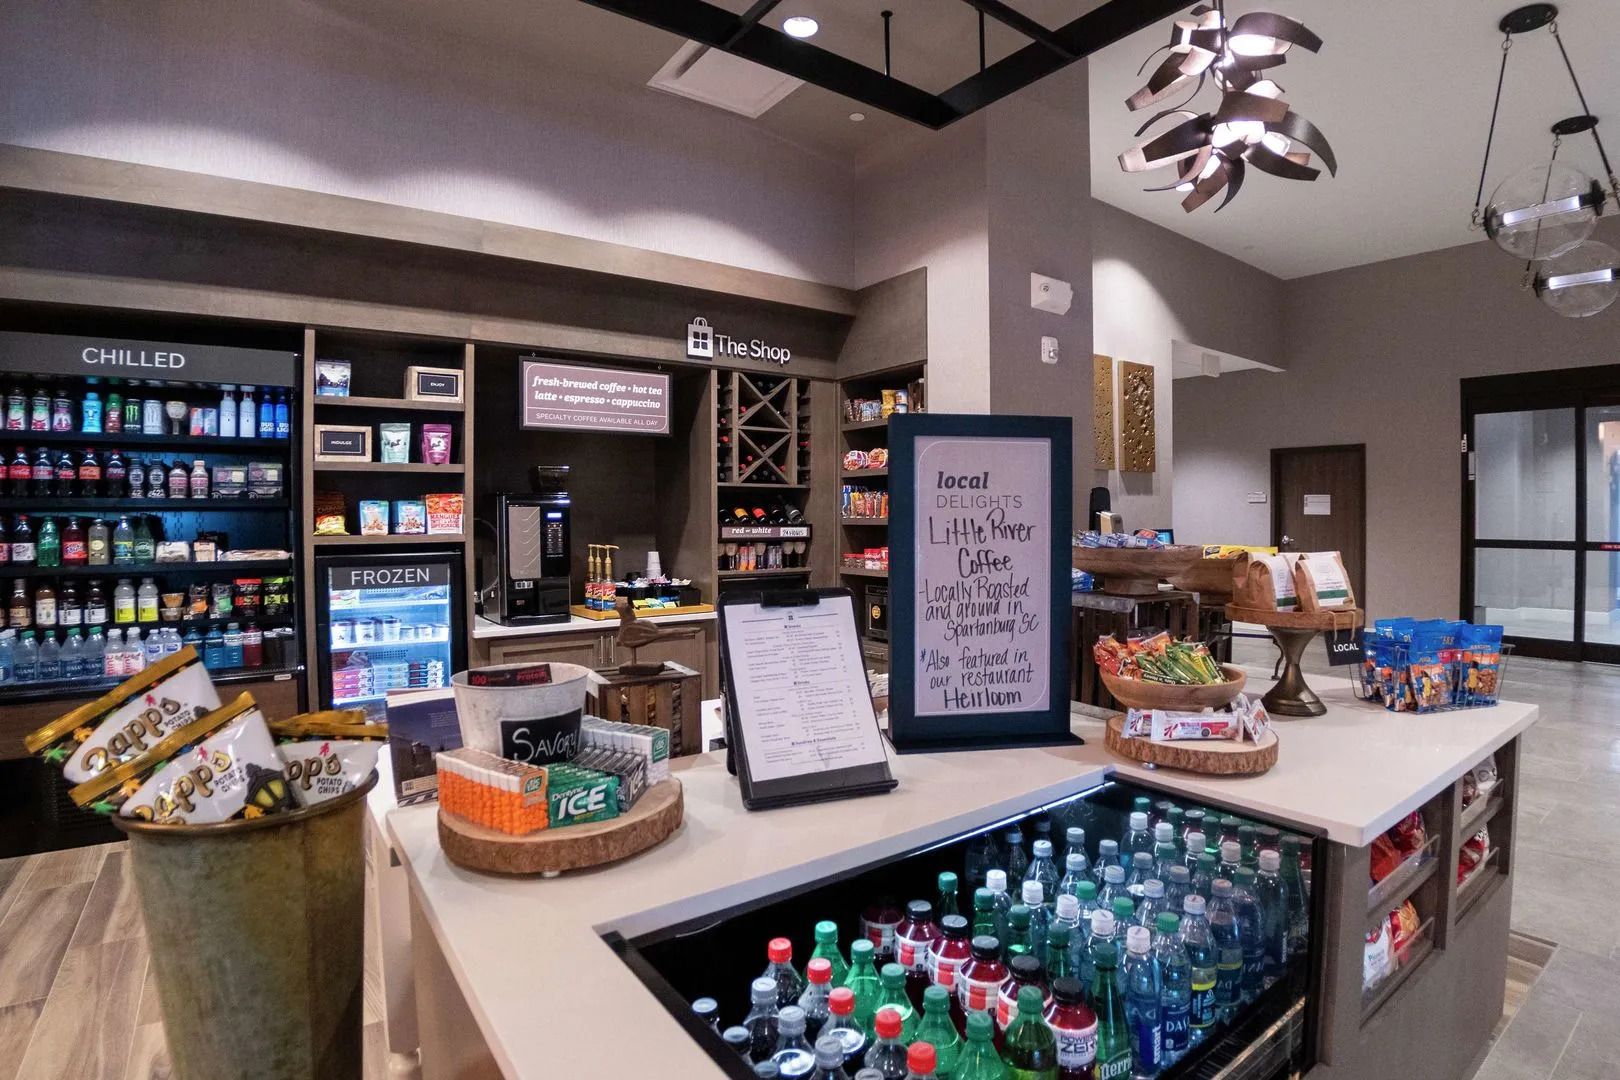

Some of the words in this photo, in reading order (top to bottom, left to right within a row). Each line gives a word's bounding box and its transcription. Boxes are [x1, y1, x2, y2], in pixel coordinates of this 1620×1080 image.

[82, 348, 185, 368] CHILLED
[715, 334, 747, 355] The
[750, 340, 790, 364] Shop
[532, 376, 598, 390] fresh-brewed
[600, 383, 626, 393] coffee
[632, 384, 647, 393] hot
[648, 386, 662, 395] tea
[534, 391, 557, 400] latte
[564, 396, 604, 404] espresso
[612, 398, 660, 408] cappuccino
[536, 412, 572, 421] SPECIALTY
[599, 416, 632, 425] AVAILABLE
[937, 471, 989, 489] local
[936, 495, 1022, 508] DELIGHTS
[930, 516, 986, 545] Little
[986, 507, 1036, 542] River
[958, 548, 1013, 578] Coffee
[351, 568, 430, 585] FROZEN
[973, 573, 1029, 600] Roasted
[926, 600, 951, 621] and
[957, 600, 1000, 623] ground
[1008, 600, 1024, 615] in
[944, 618, 1015, 646] Spartanburg
[1019, 613, 1039, 634] SC
[1334, 643, 1359, 652] LOCAL
[959, 646, 1008, 669] featured
[1014, 648, 1028, 663] in
[930, 675, 952, 689] our
[961, 663, 1034, 687] restaurant
[944, 687, 1021, 709] Heirloom
[164, 710, 191, 727] POTATO
[317, 778, 342, 786] POTATO
[552, 786, 584, 801] Dentyne
[558, 784, 608, 820] ICE
[1061, 1042, 1097, 1054] ZER
